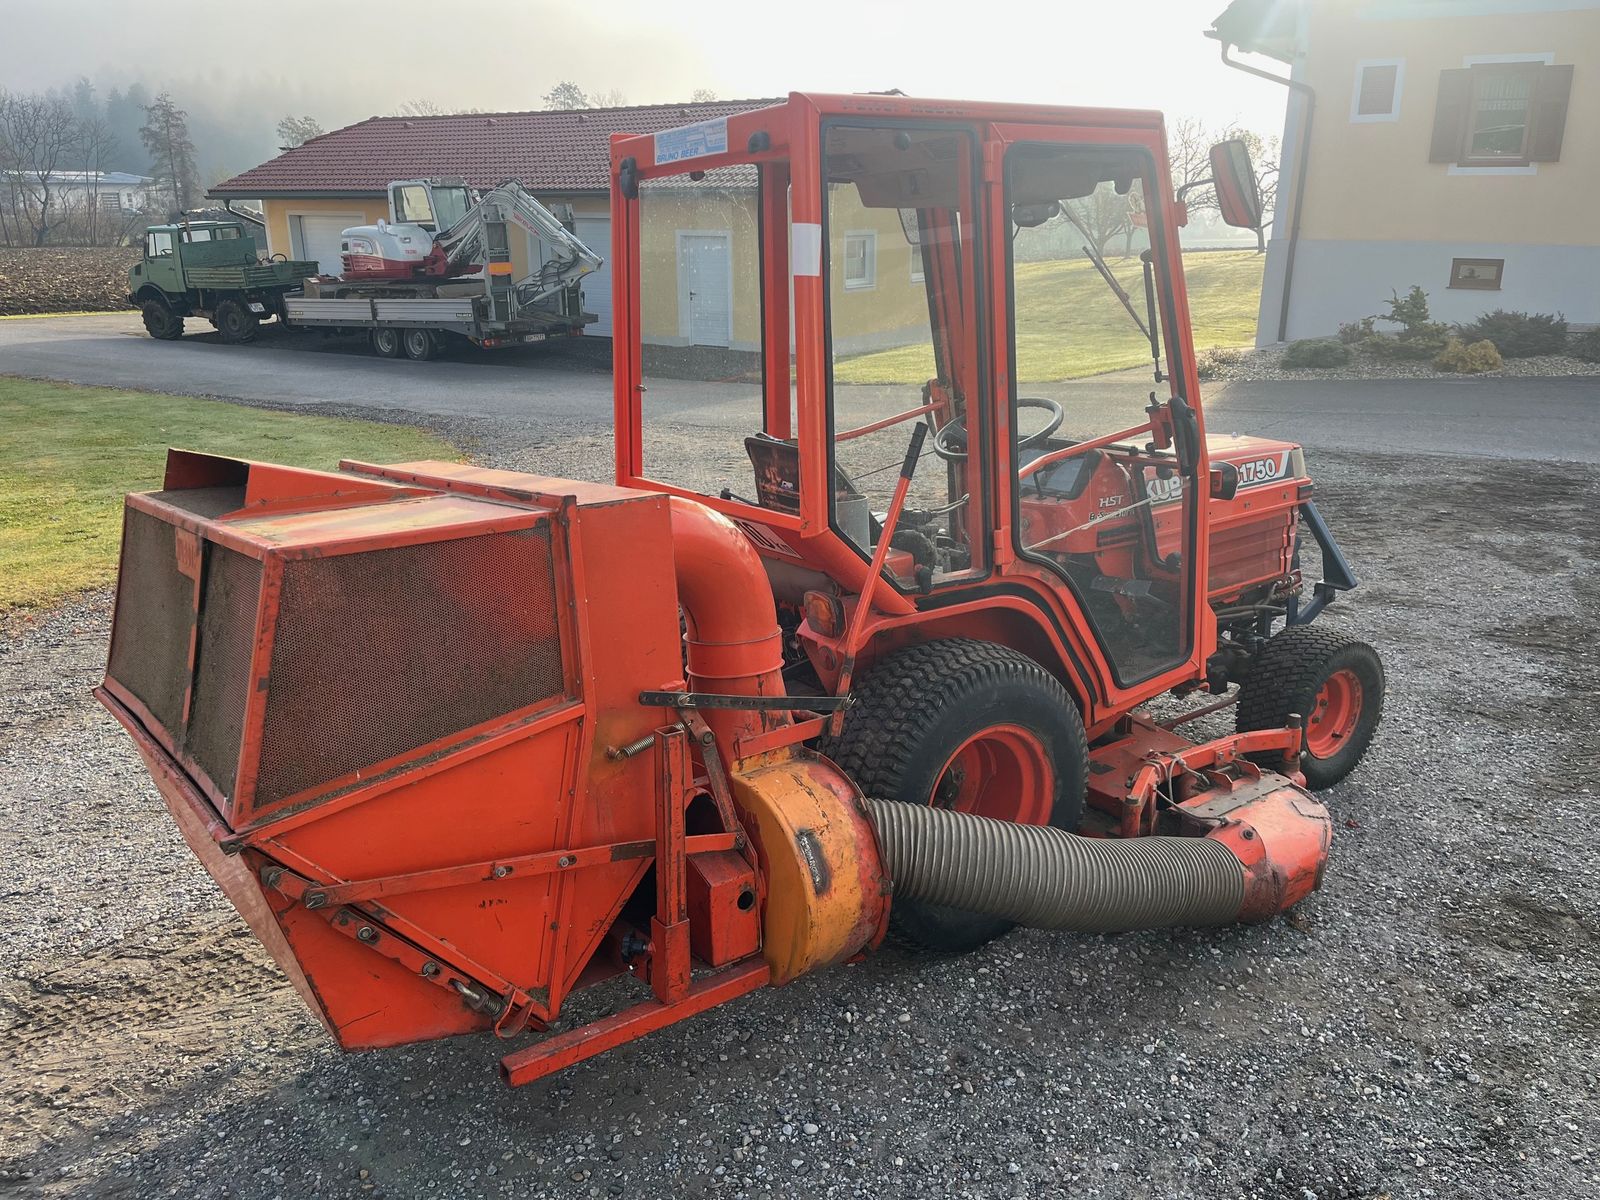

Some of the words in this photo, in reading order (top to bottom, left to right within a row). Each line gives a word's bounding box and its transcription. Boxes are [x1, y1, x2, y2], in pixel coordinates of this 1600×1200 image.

[657, 152, 679, 163] BRUNO
[1146, 475, 1183, 500] KUB
[1238, 458, 1277, 483] 1750
[1099, 495, 1124, 508] HST
